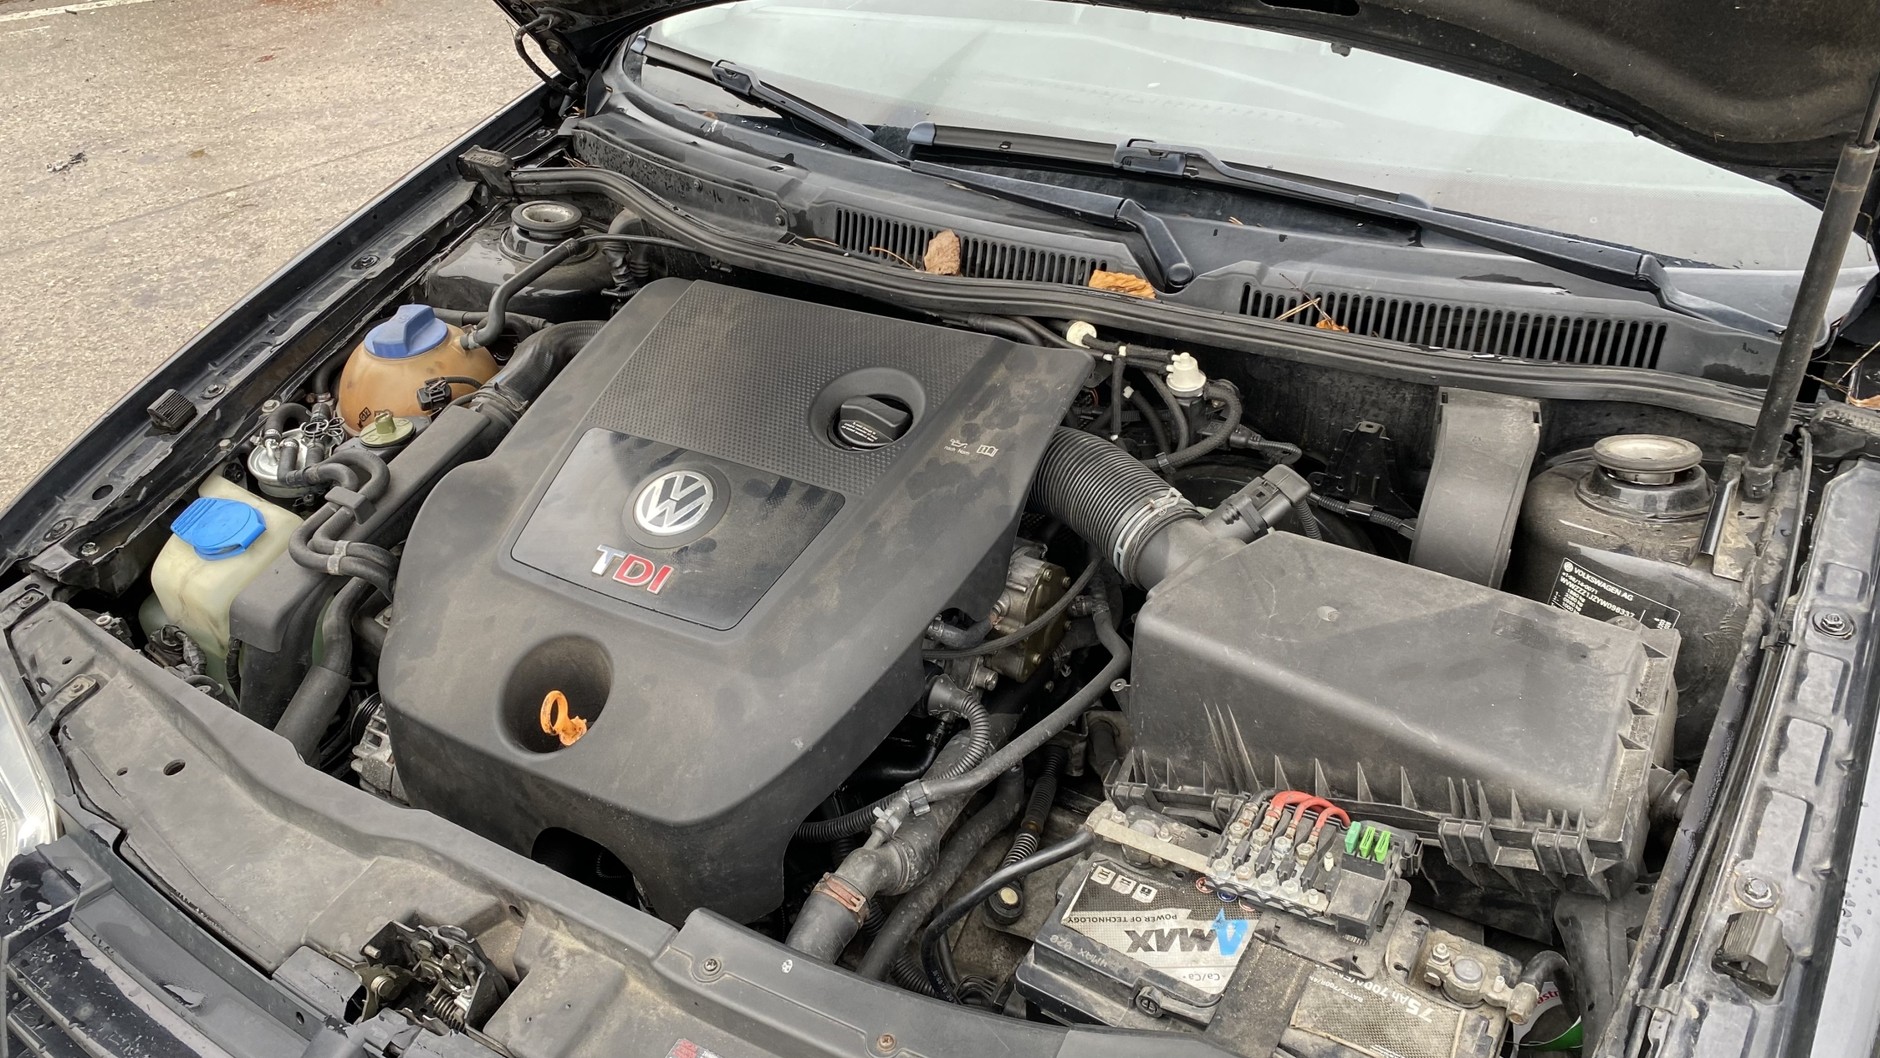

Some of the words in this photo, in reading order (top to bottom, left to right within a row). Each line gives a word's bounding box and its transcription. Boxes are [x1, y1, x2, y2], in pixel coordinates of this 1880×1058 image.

[591, 544, 674, 594] TDI
[1574, 567, 1622, 596] VOLKSWAGEN
[1621, 591, 1634, 602] AG
[1067, 915, 1128, 924] TECHNOLOGY
[1130, 915, 1142, 924] OF
[1144, 913, 1178, 924] POWER
[1188, 972, 1221, 982] Ca/Ca
[1537, 990, 1559, 1004] astr
